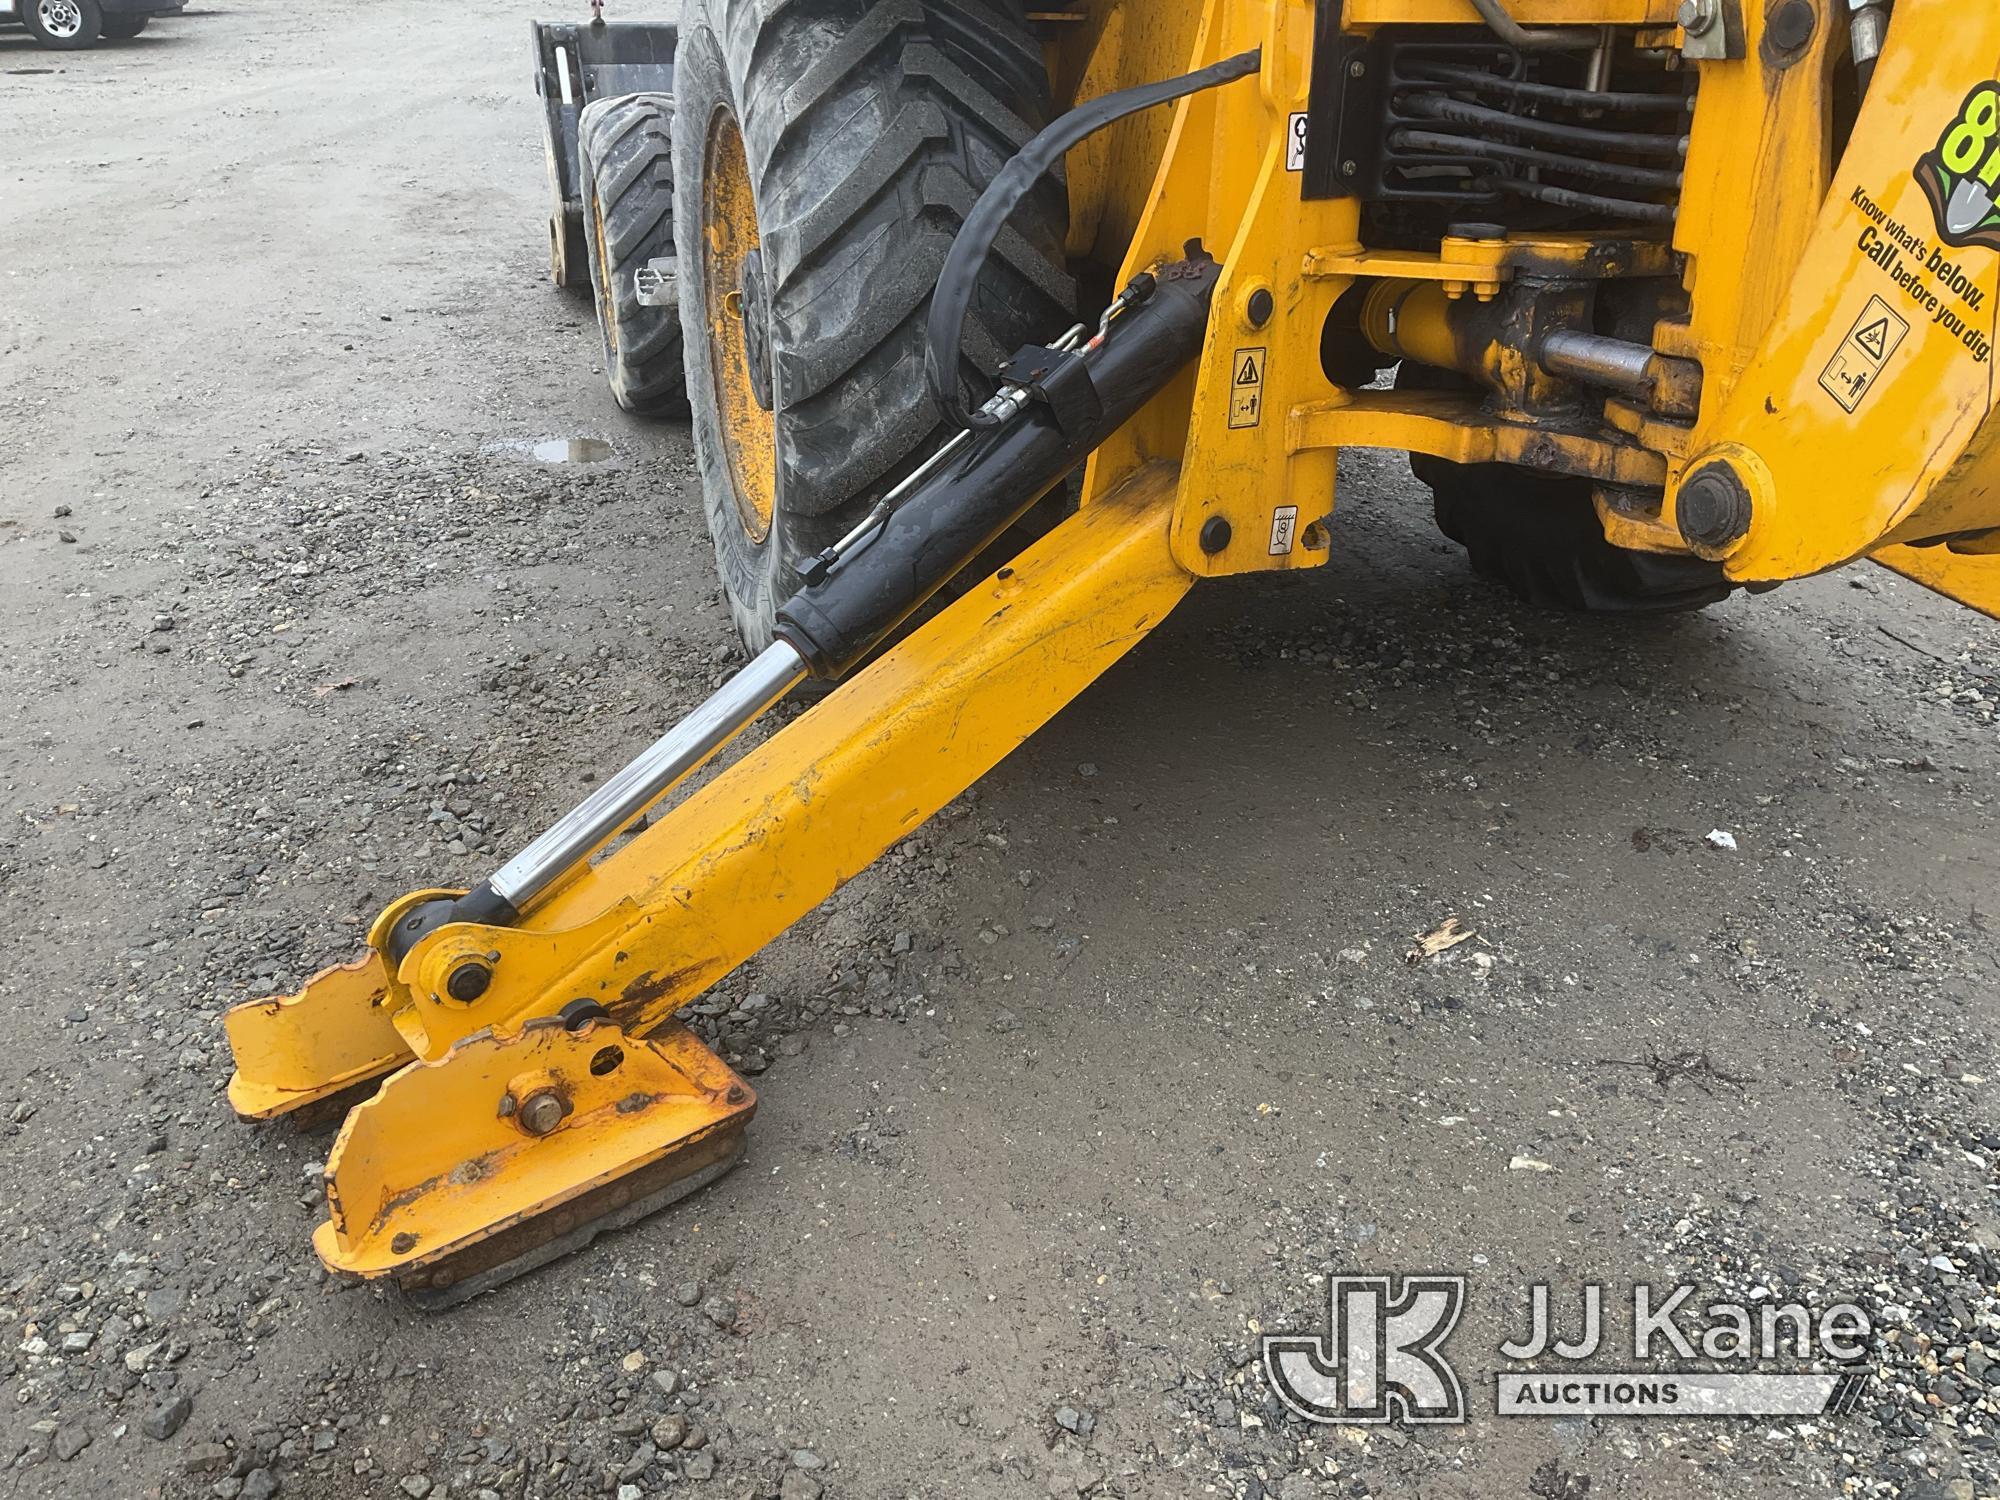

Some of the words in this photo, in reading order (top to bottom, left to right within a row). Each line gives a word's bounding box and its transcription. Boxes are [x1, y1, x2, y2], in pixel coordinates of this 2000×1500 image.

[1850, 185, 1887, 225] Know
[1884, 218, 1927, 261] what's
[1925, 246, 1985, 312] below.
[1857, 225, 1899, 272] Call
[1890, 260, 1939, 312] before
[1932, 304, 1966, 337] you
[1962, 329, 1991, 363] dig.
